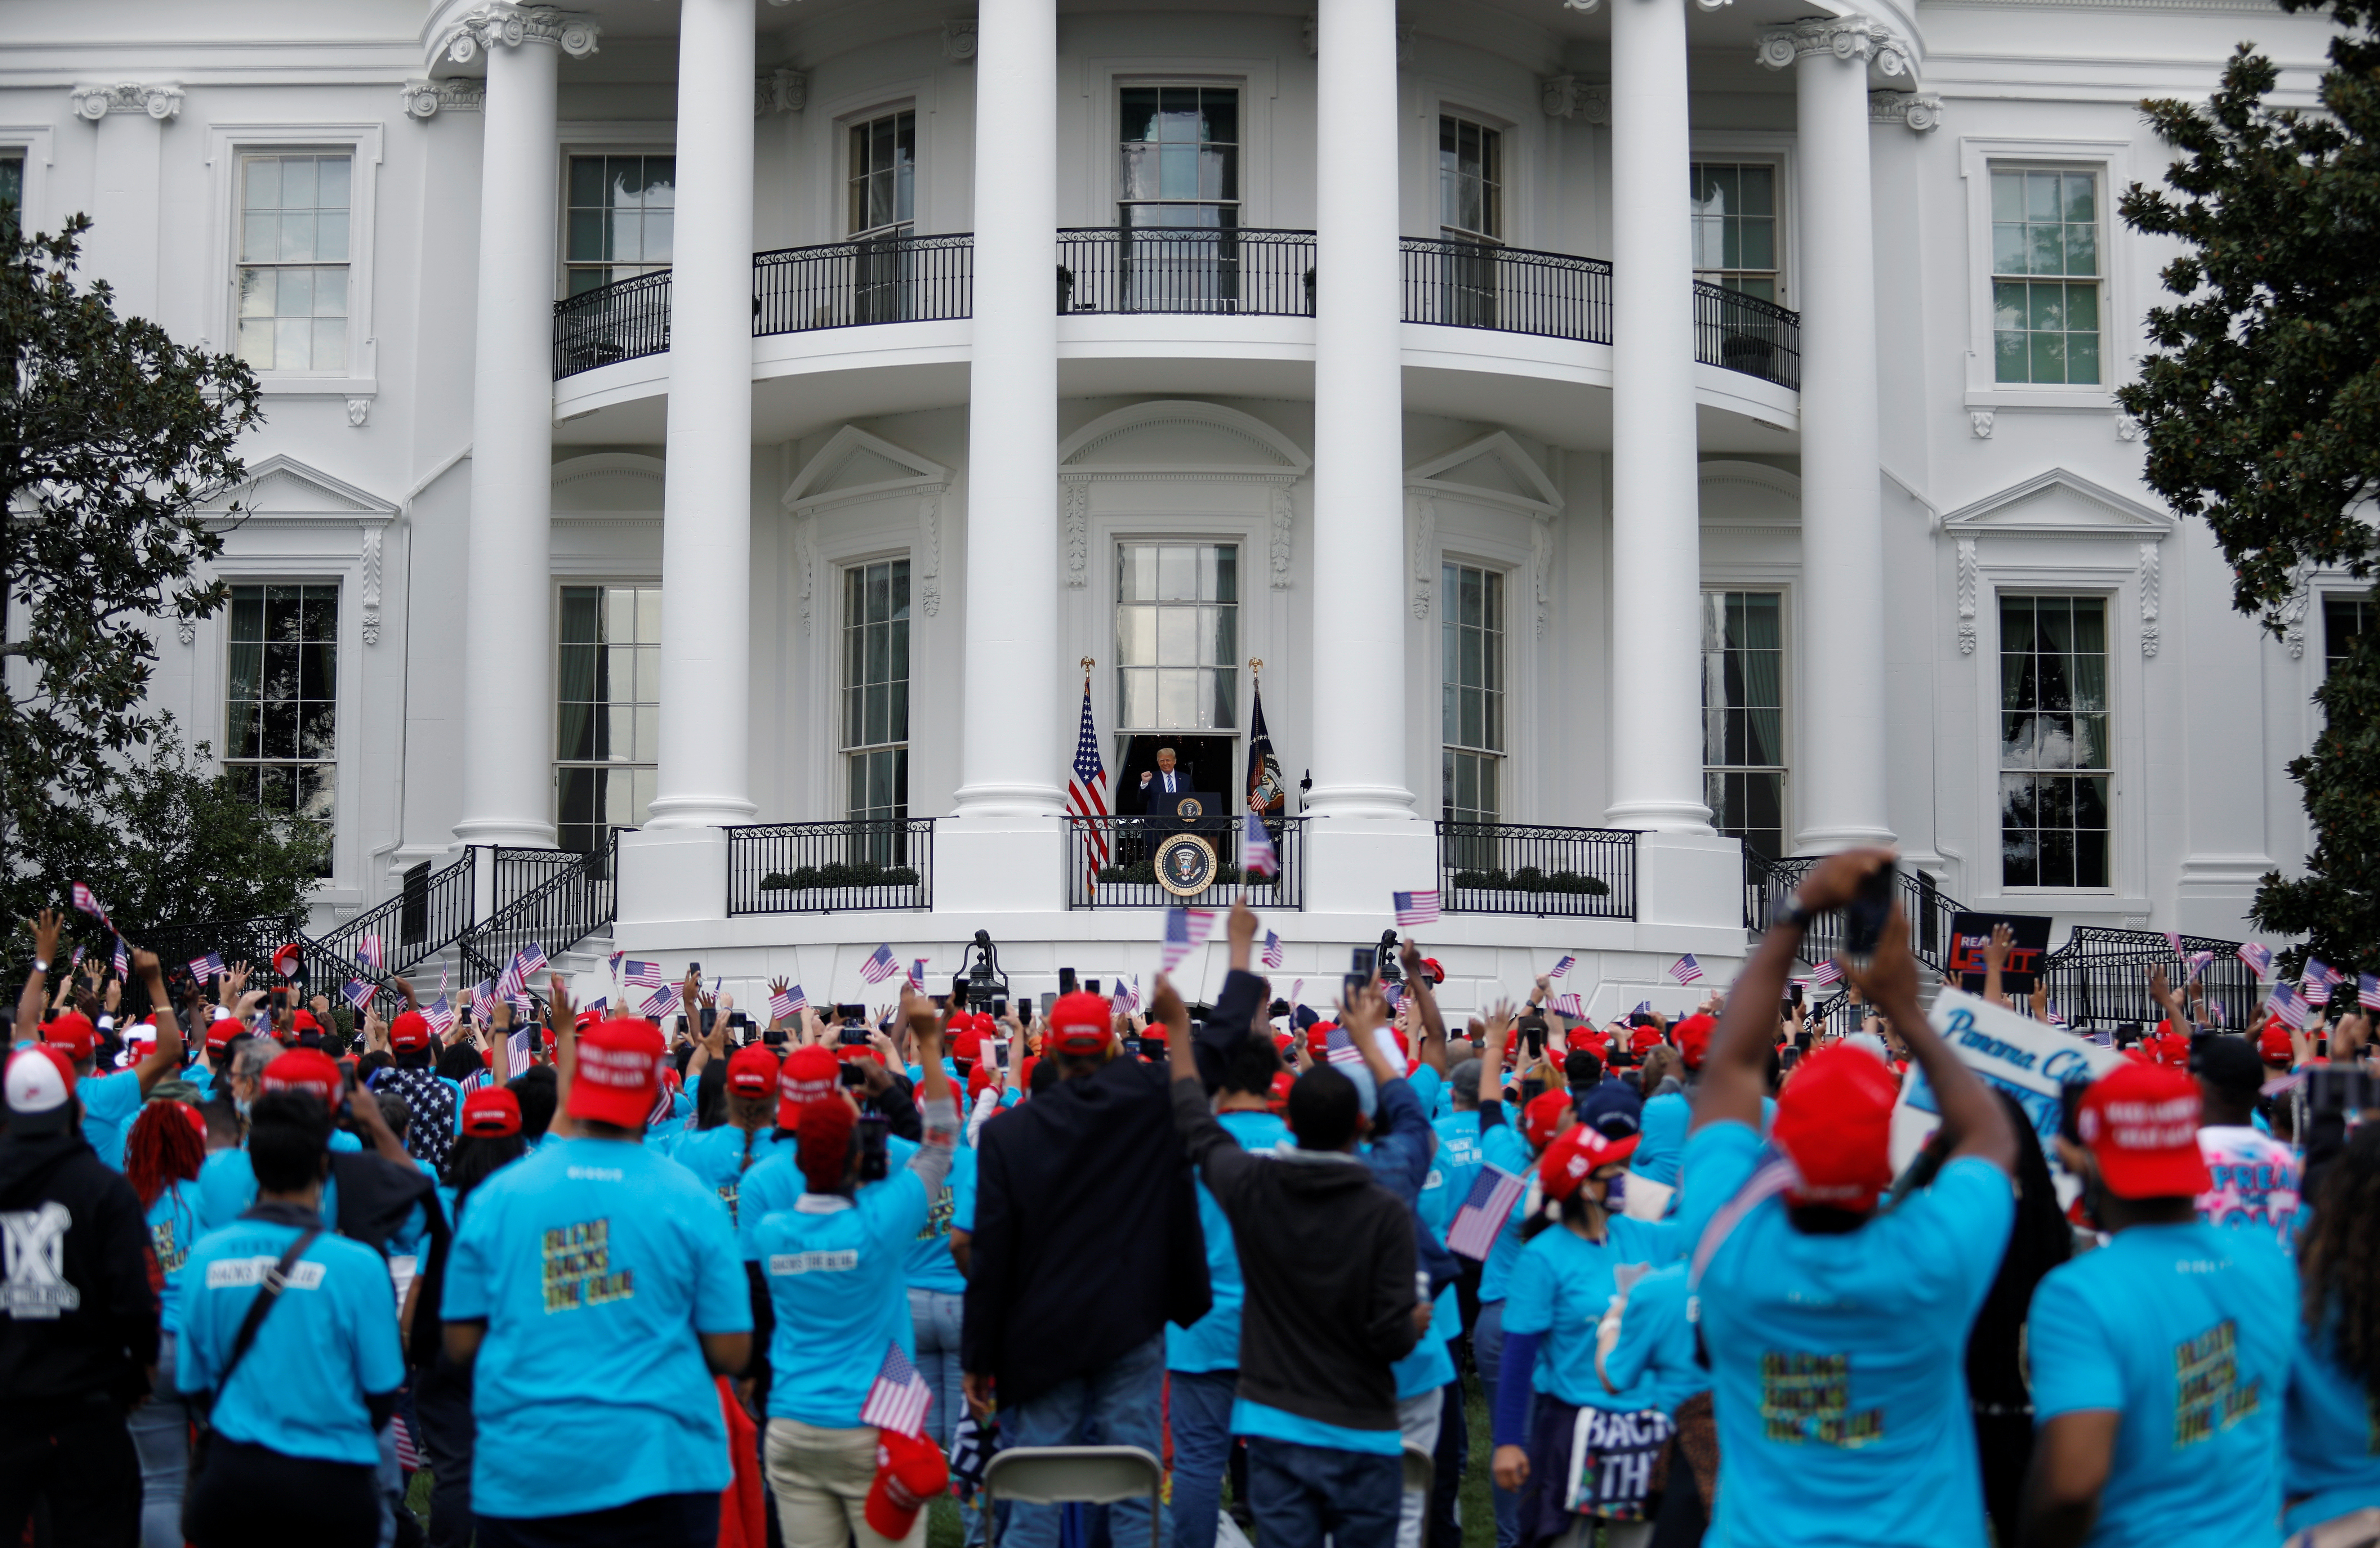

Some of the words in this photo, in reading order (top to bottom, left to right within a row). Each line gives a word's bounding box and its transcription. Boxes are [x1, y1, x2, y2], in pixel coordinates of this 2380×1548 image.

[1156, 836, 1184, 863] PRESIDENT
[1203, 844, 1215, 870] UNITED
[1164, 880, 1180, 893] SEAL
[1191, 874, 1212, 893] STATES
[1949, 932, 2037, 973] LEIT
[1943, 1008, 2037, 1070] Panama
